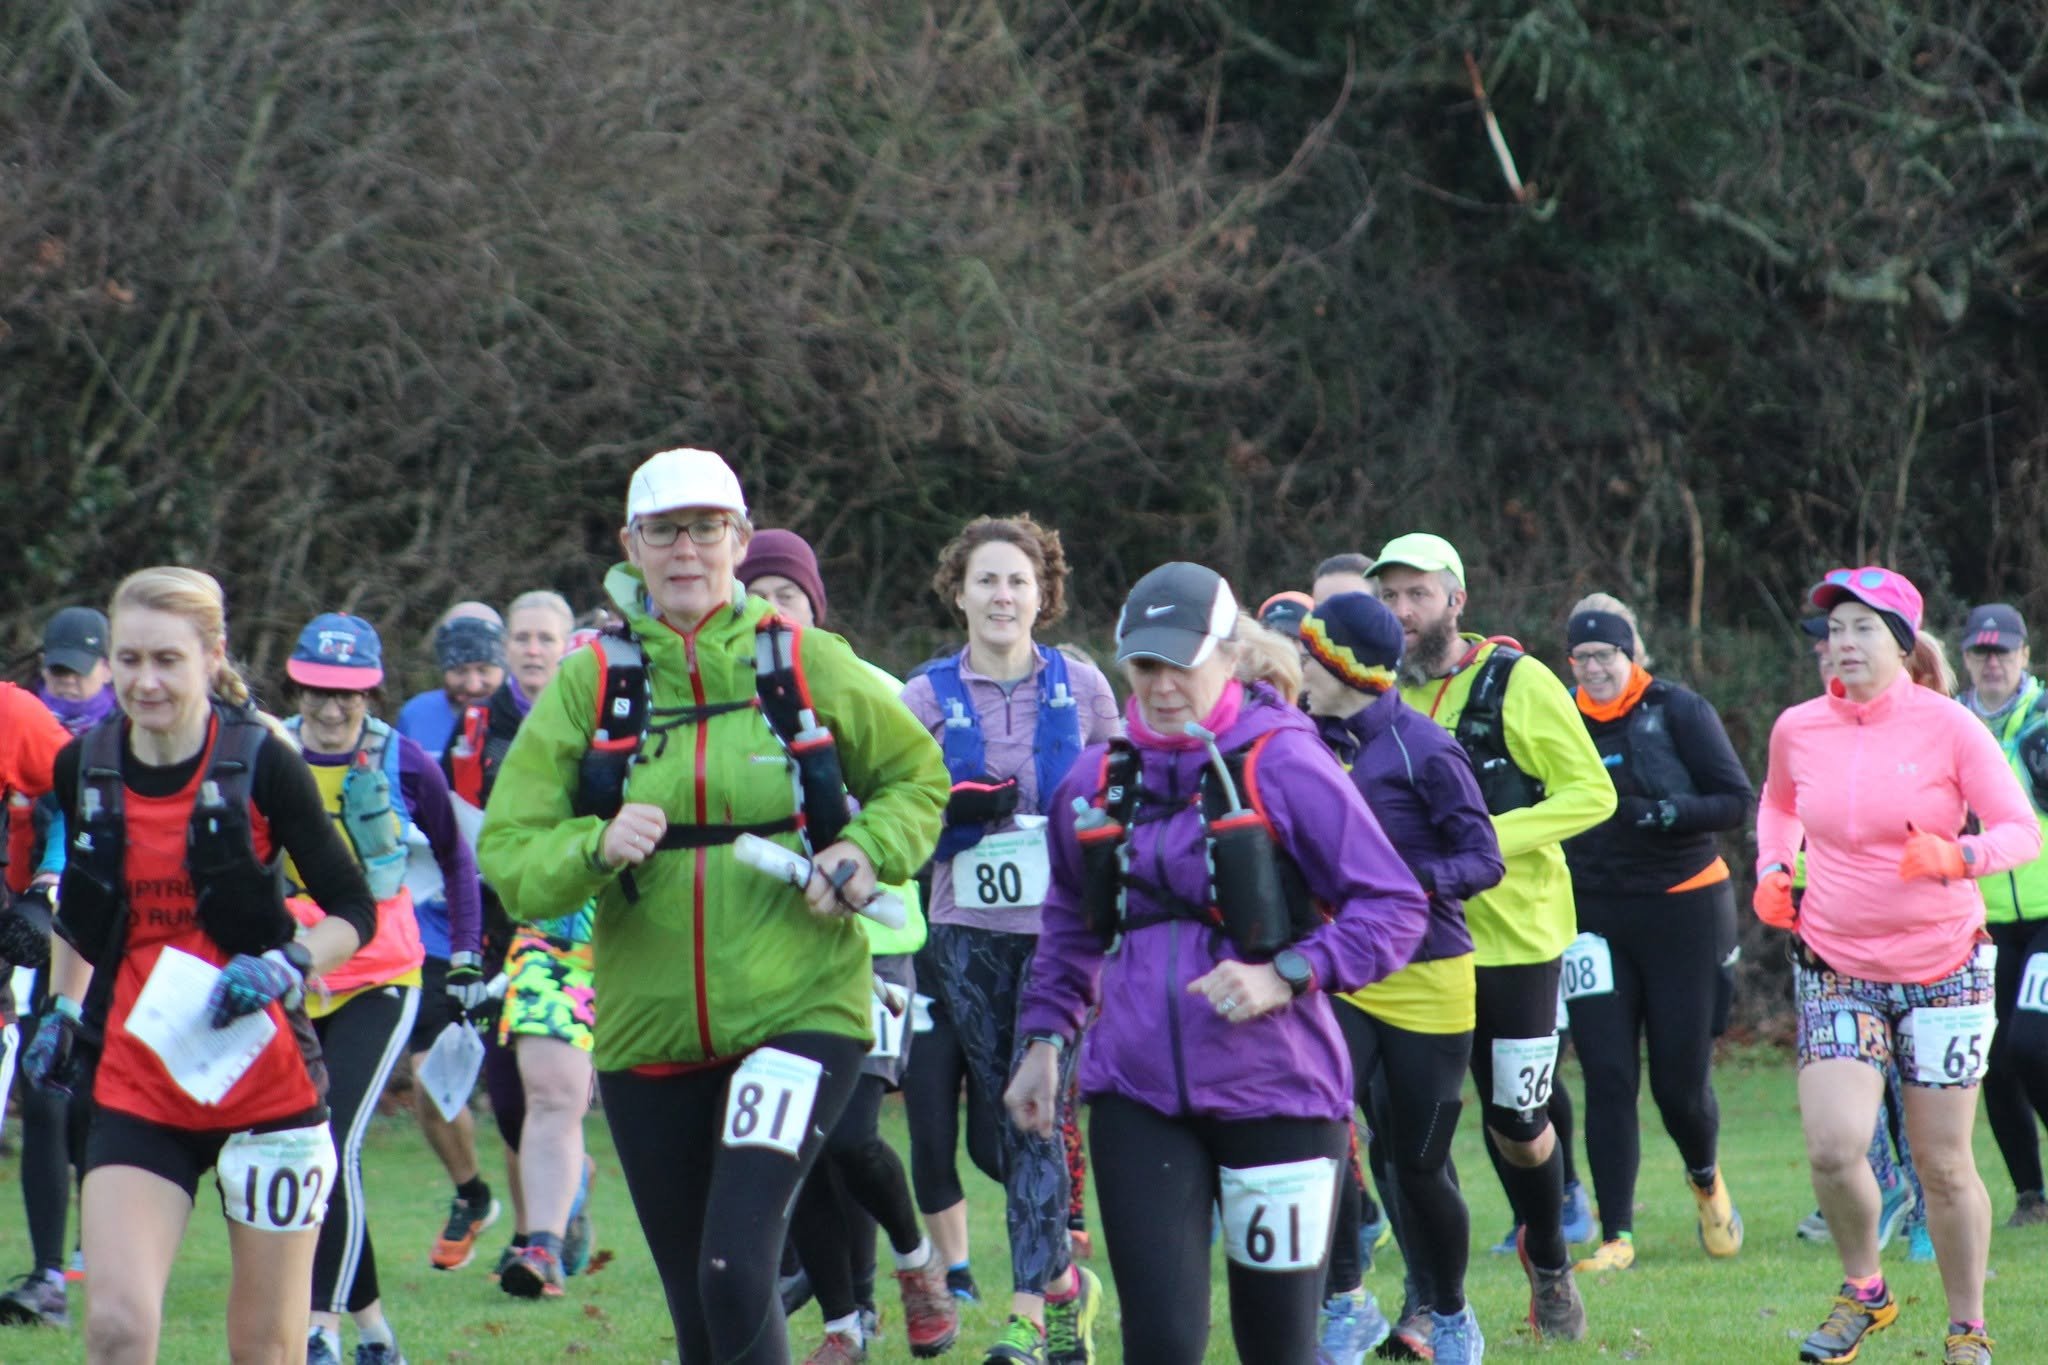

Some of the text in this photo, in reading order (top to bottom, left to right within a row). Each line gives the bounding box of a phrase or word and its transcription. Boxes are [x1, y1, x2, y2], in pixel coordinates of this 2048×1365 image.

[976, 861, 1022, 904] 80
[1943, 1033, 1982, 1079] 65
[732, 1081, 793, 1141] 81
[1516, 1063, 1550, 1107] 36
[244, 1164, 323, 1227] 102
[1246, 1203, 1300, 1263] 61
